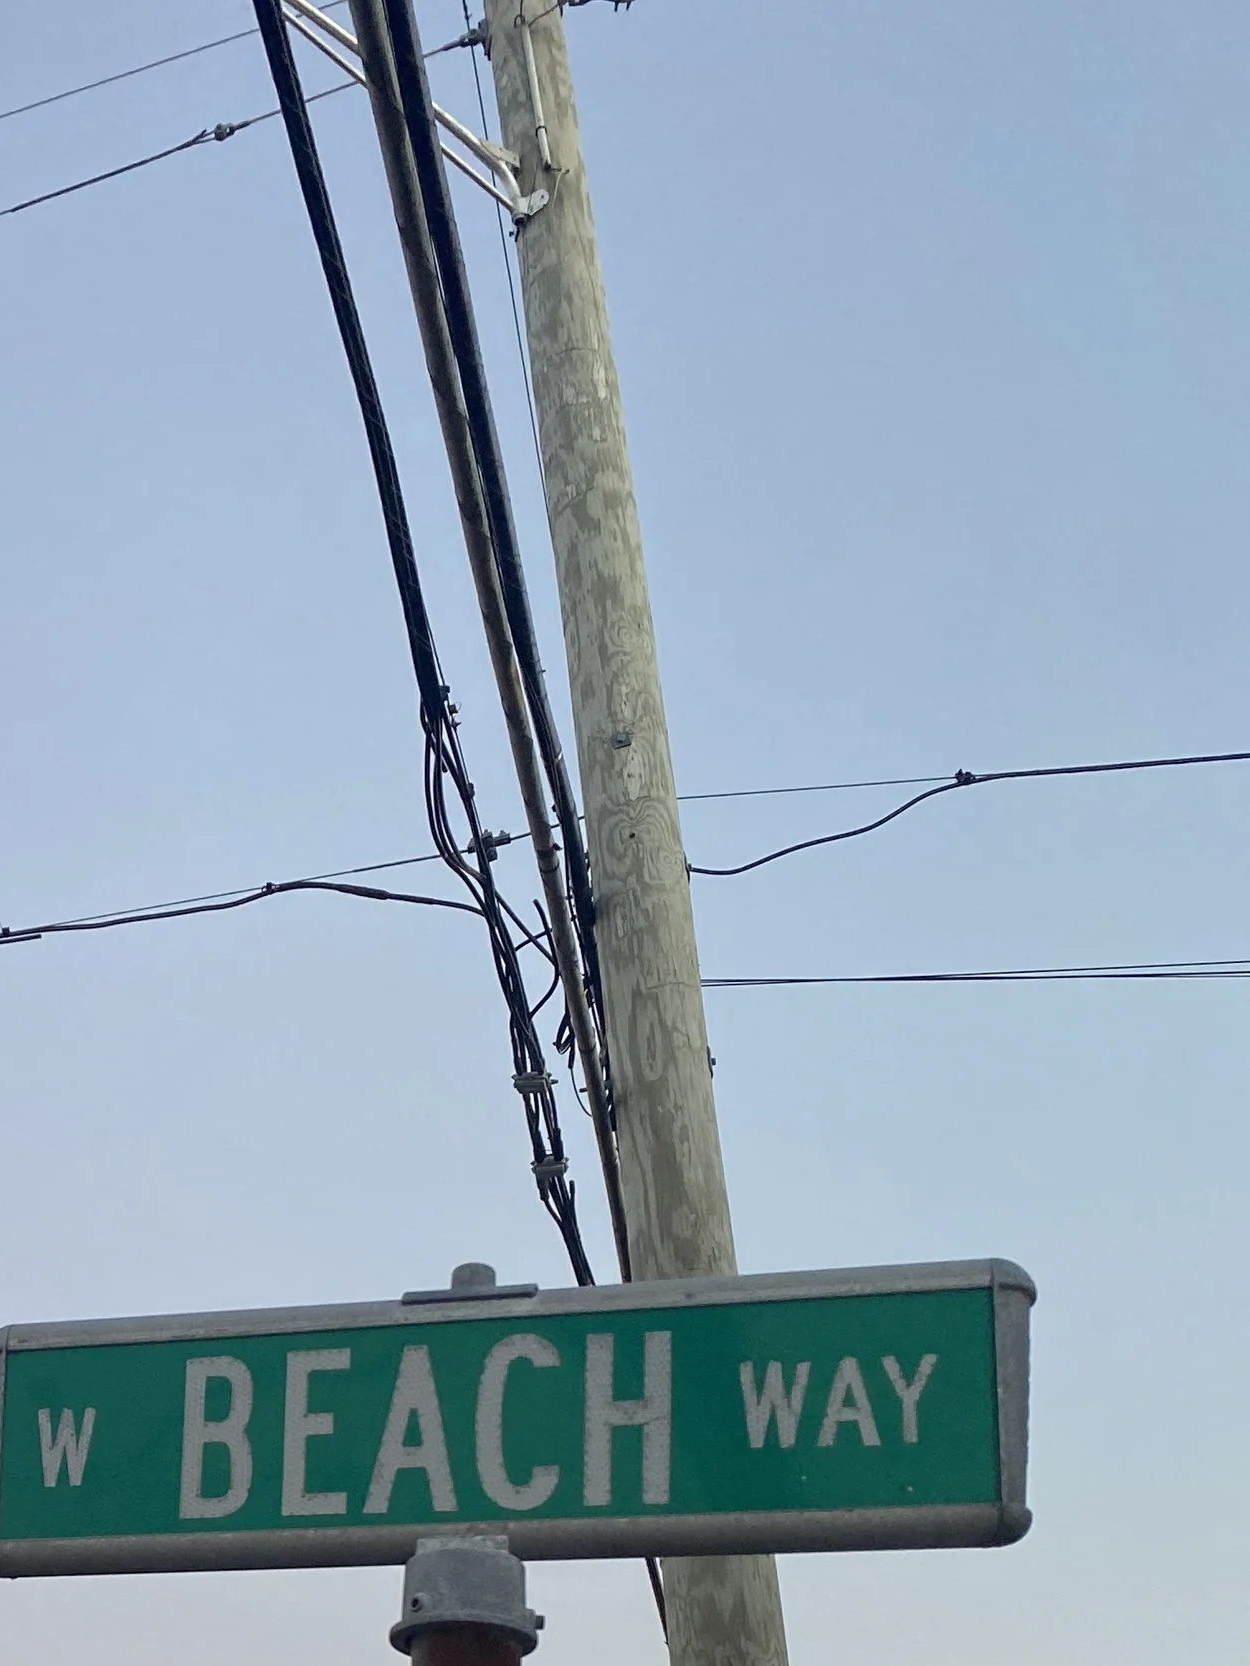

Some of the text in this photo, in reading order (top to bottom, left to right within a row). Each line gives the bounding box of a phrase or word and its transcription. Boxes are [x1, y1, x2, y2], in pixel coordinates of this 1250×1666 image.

[37, 1332, 937, 1520] W BEACH WAY
